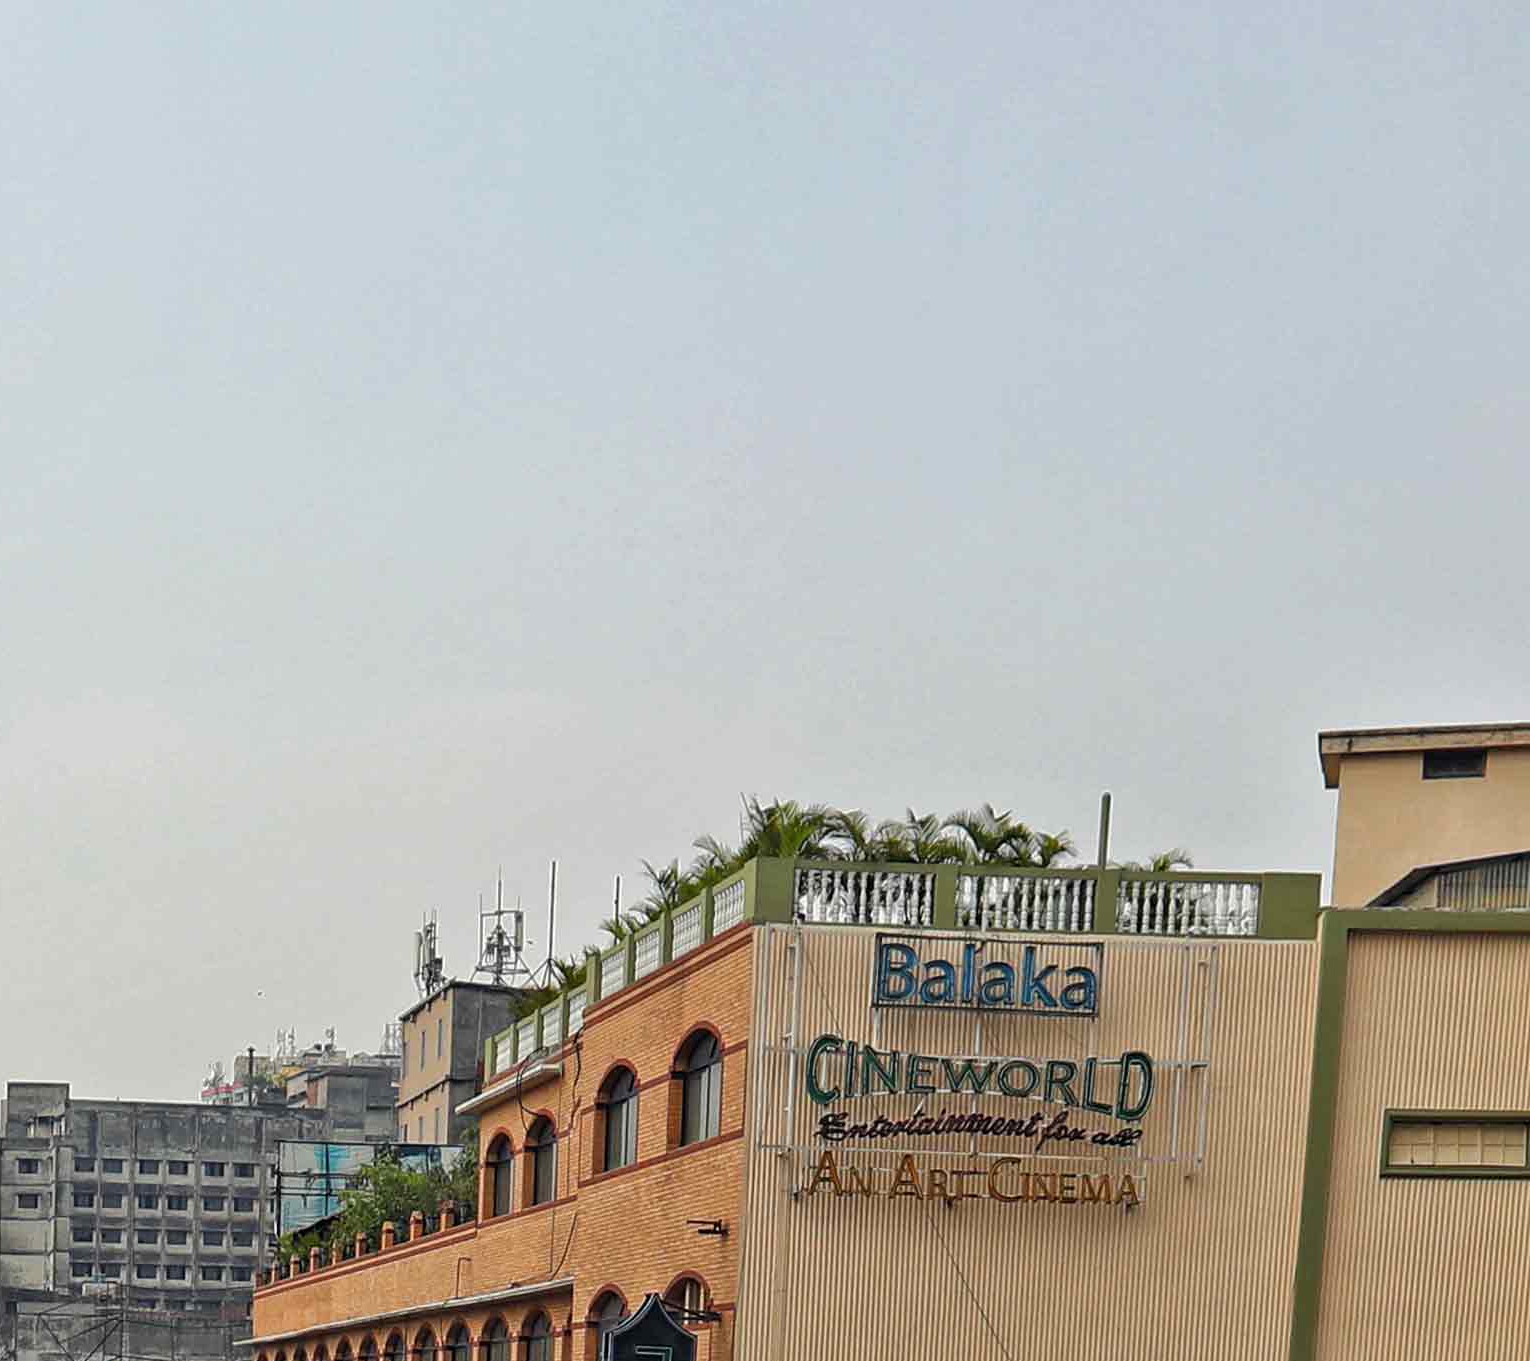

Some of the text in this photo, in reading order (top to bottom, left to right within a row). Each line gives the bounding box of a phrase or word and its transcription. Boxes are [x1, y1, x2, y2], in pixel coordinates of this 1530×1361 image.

[876, 941, 1098, 1010] Balaka
[806, 1034, 1155, 1121] CINEWORLD
[815, 1103, 1143, 1148] Entertainment for all
